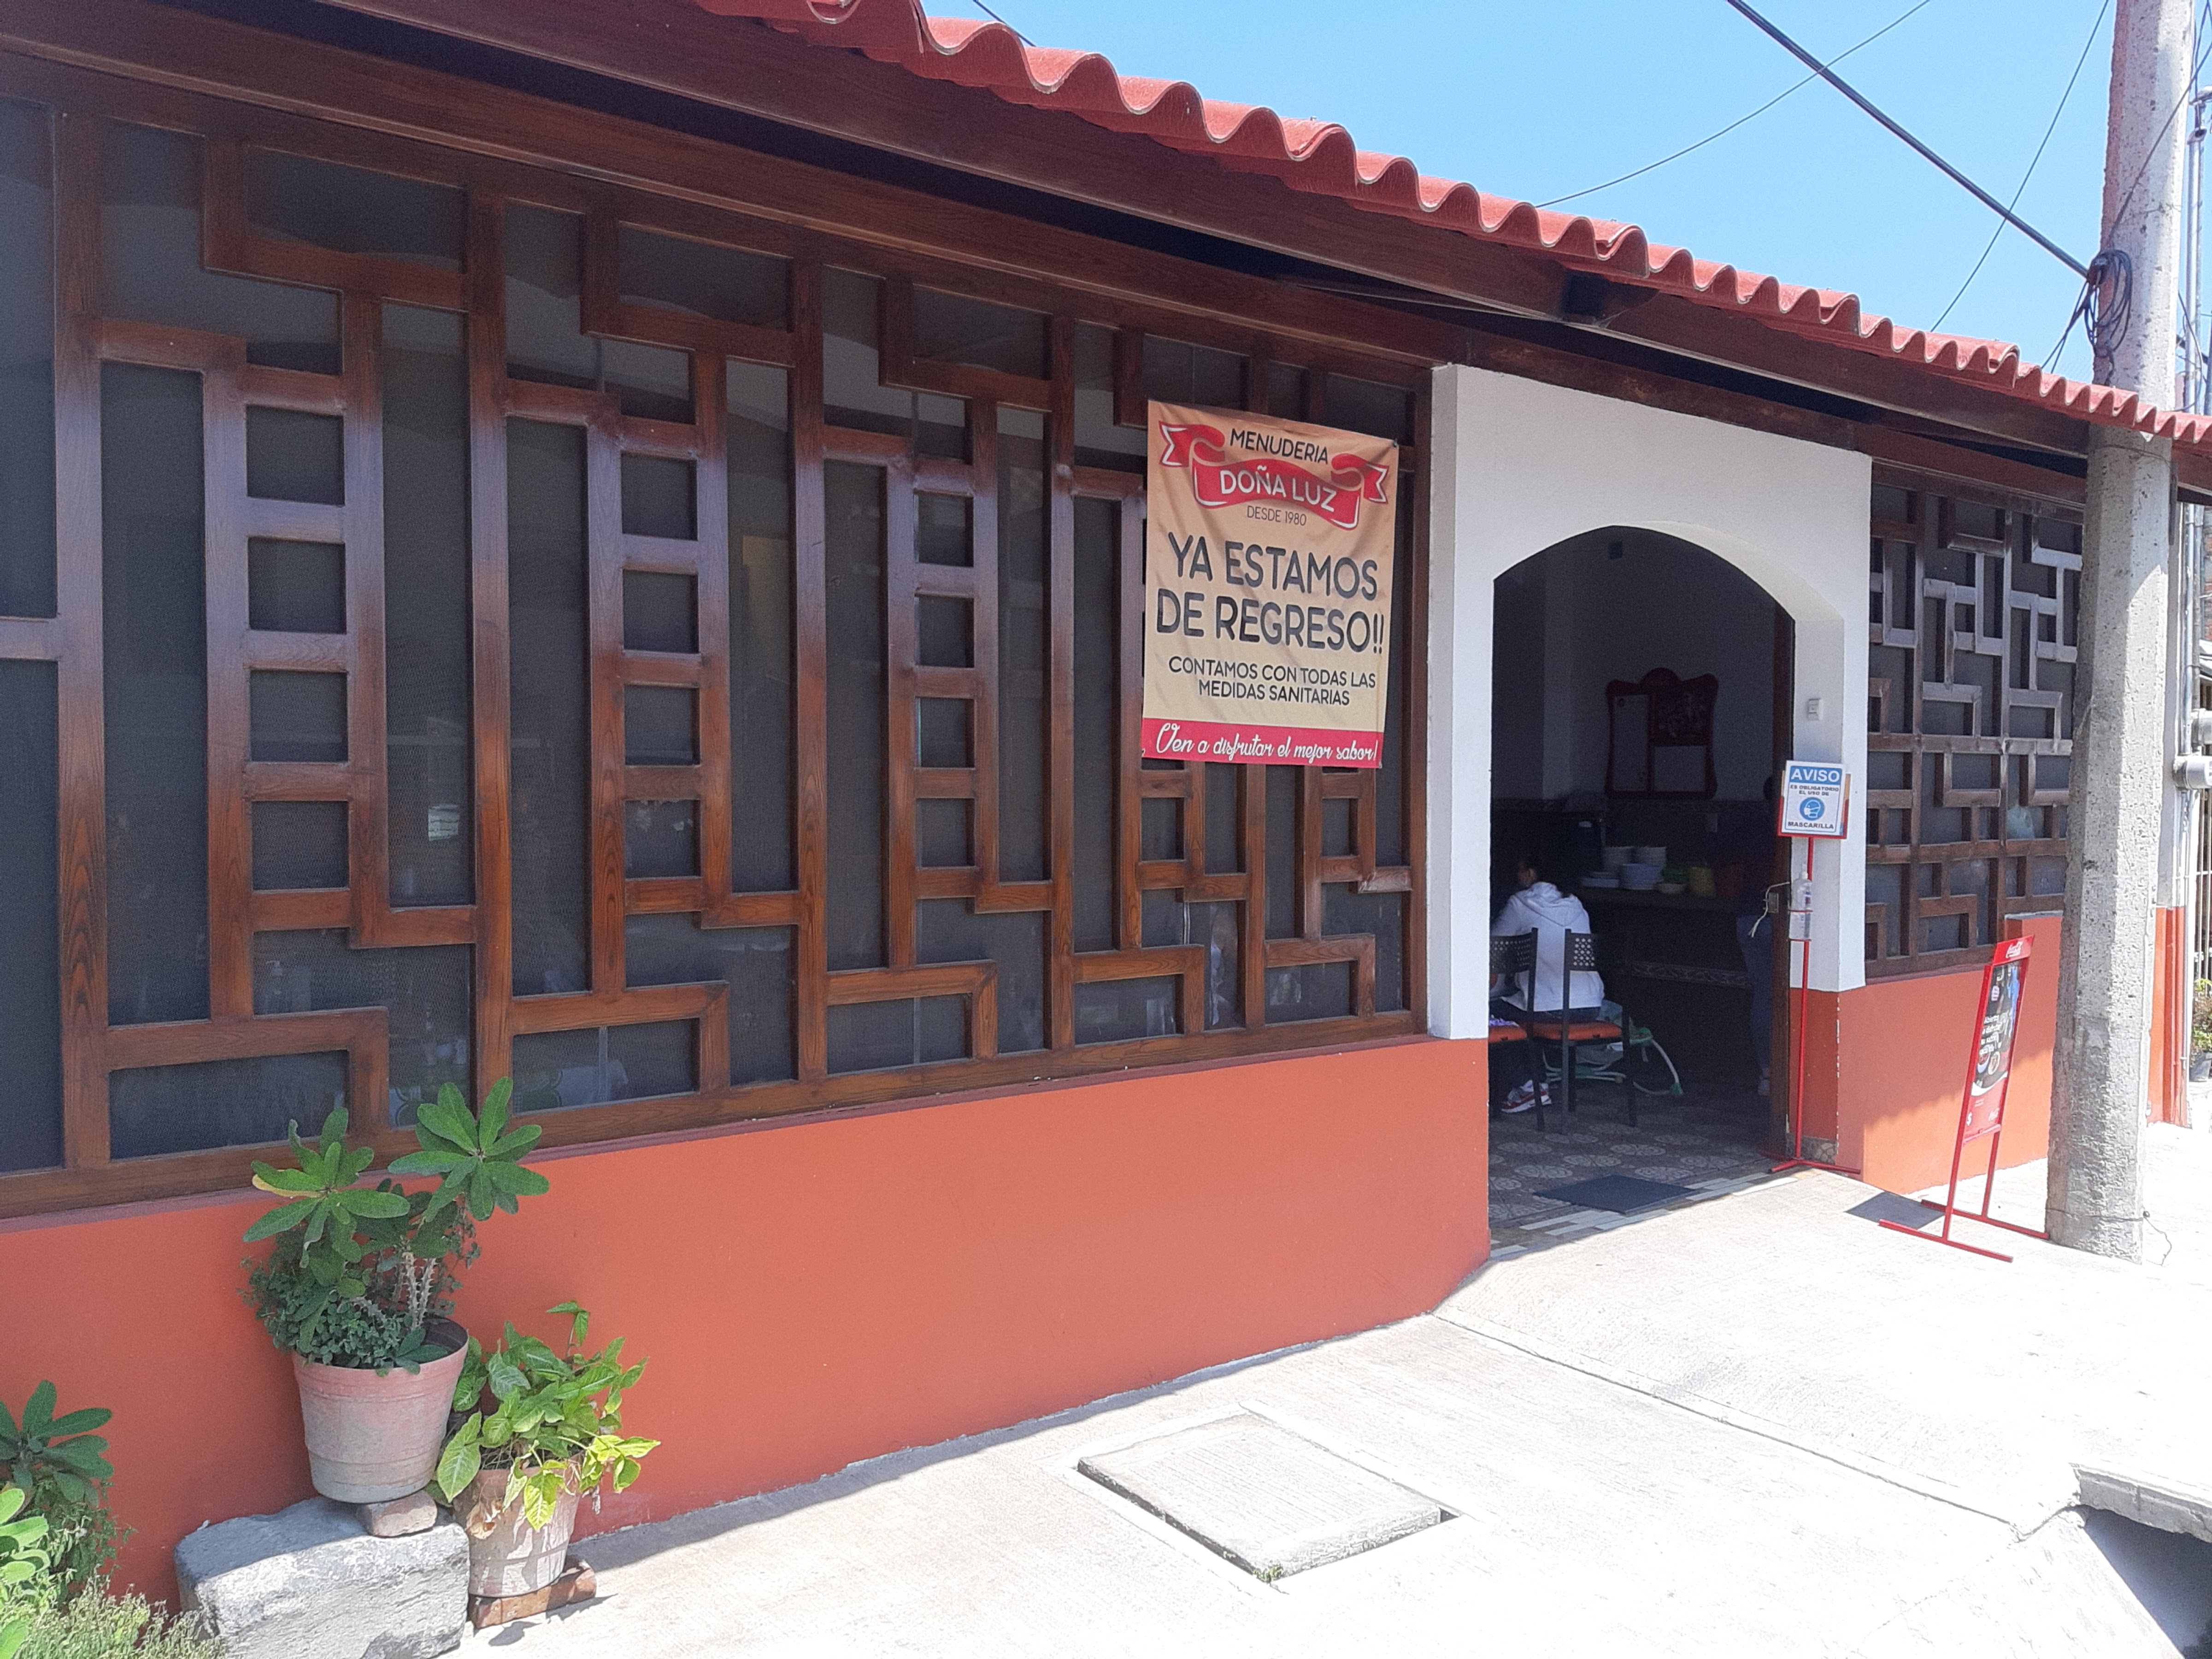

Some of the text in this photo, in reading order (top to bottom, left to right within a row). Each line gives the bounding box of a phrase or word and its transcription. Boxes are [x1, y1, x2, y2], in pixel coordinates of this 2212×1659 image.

[1230, 429, 1329, 465] MENUDERIA
[1220, 465, 1337, 512] DOÑA LUZ
[1247, 506, 1307, 526] DESDE 1980
[1168, 531, 1378, 600] YA ESTAMOS
[1157, 588, 1383, 654] DE REGRESO!!
[1169, 656, 1376, 688] CONTAMOS CON TODAS LAS
[1199, 680, 1350, 706] MEDIDAS SANITARIAS
[1156, 723, 1378, 763] Ven a disfrutar el mejor sabor!
[1791, 769, 1840, 782] AVISO
